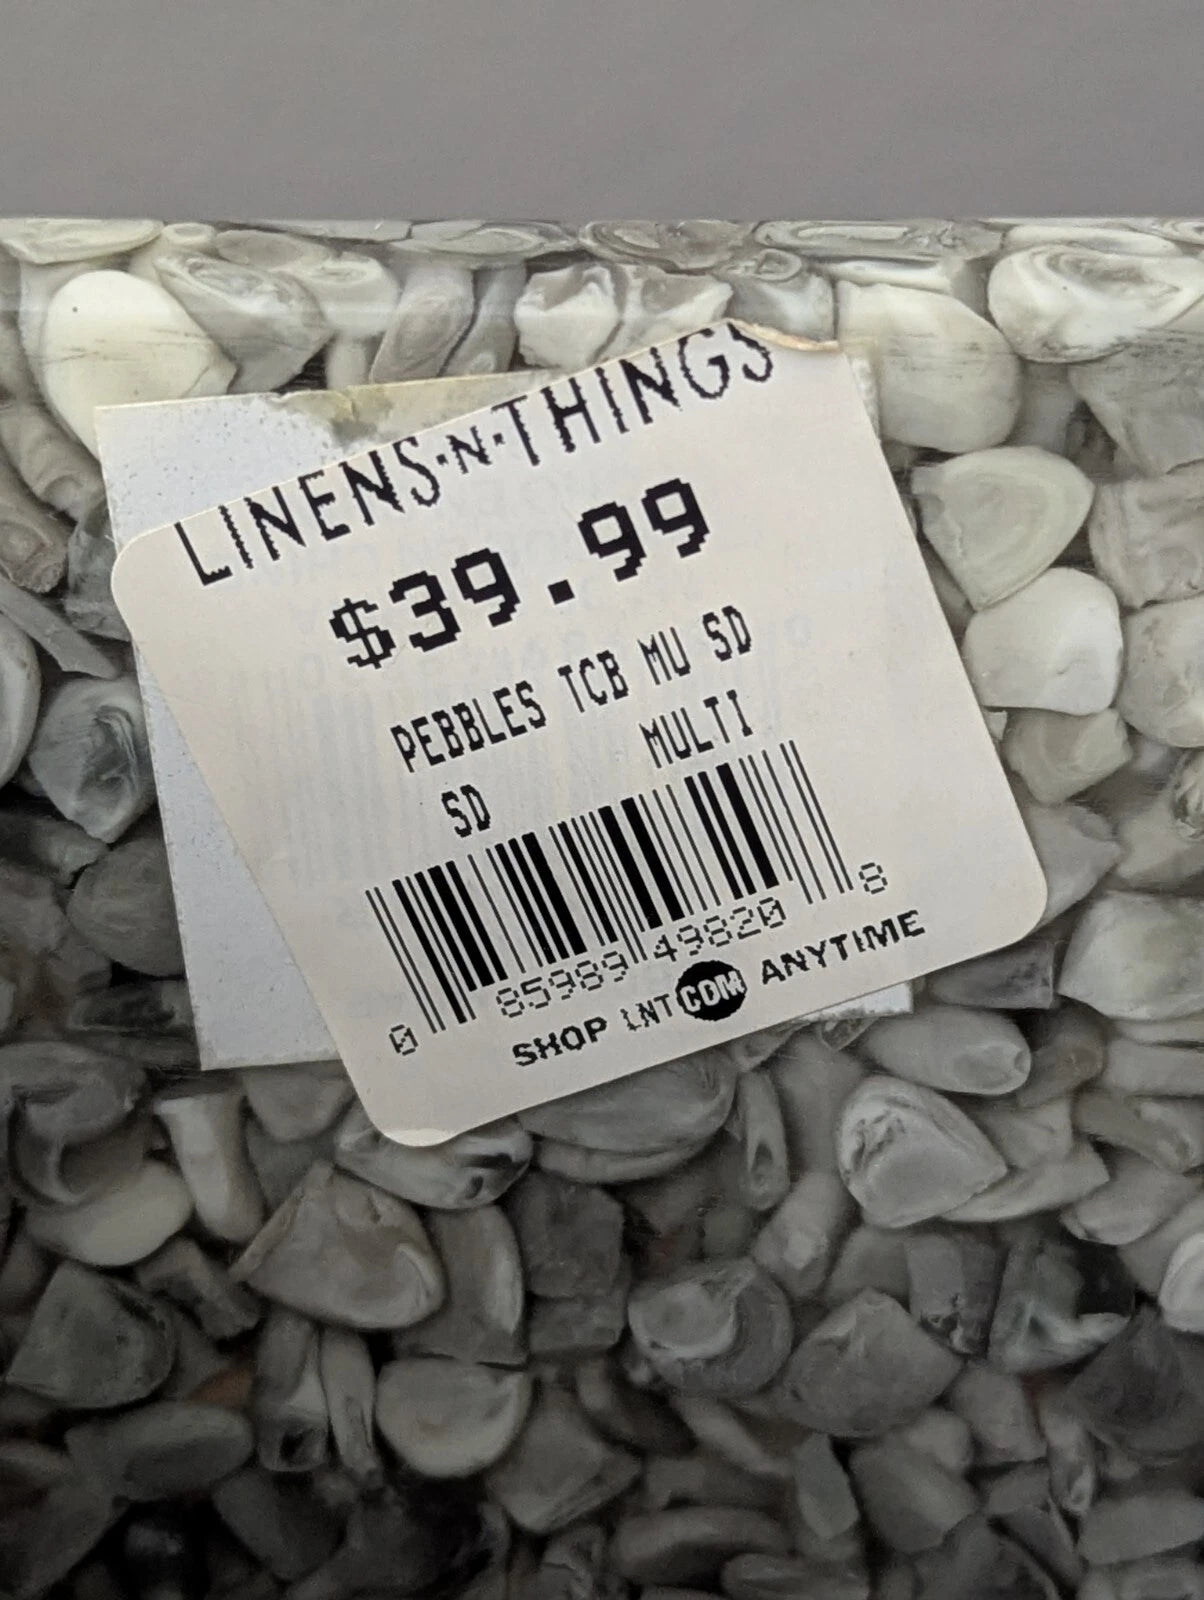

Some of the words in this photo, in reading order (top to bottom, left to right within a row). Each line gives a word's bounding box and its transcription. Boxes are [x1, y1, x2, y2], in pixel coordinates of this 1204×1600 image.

[328, 478, 711, 671] $39.99
[390, 680, 546, 773] PEBBLES
[558, 650, 629, 712] TCB
[637, 626, 691, 685] MU
[702, 605, 753, 662] SD
[638, 689, 754, 769] MULTI
[441, 784, 491, 838] SD
[496, 951, 629, 1018] 85989
[653, 897, 787, 962] 49820
[859, 862, 888, 894] 8
[511, 1017, 608, 1066] SHOP
[760, 909, 926, 985] ANYTIME
